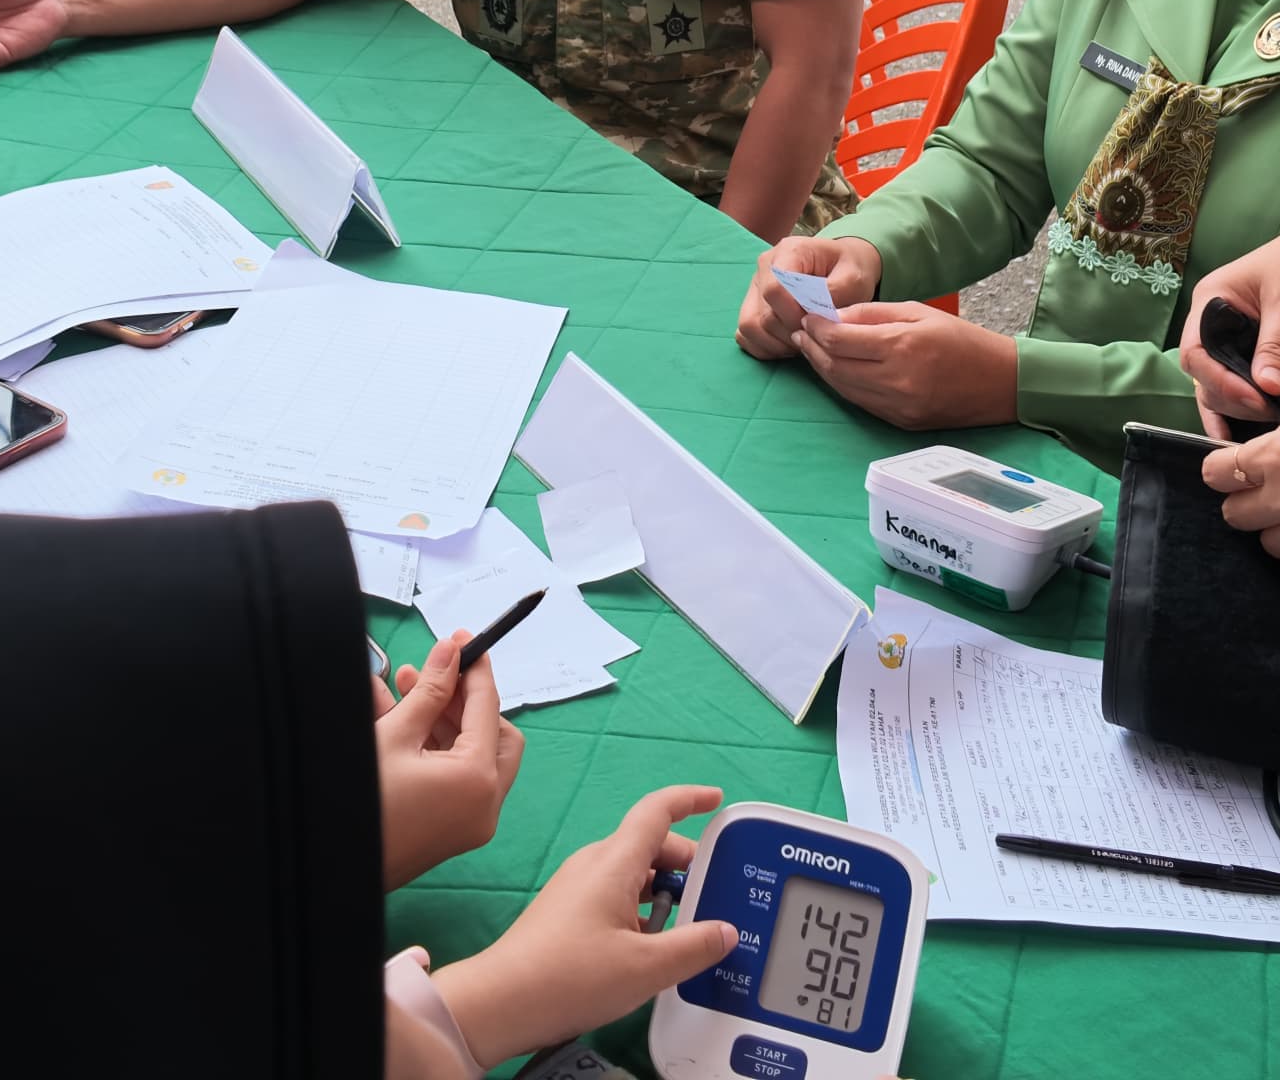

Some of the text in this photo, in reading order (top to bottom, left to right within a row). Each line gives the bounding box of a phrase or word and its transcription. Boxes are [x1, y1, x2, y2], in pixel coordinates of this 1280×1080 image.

[781, 843, 851, 875] OMRON
[748, 887, 772, 903] SYS
[739, 929, 761, 946] DIA
[800, 903, 870, 956] 142
[715, 967, 753, 987] PULSE
[803, 948, 861, 1001] 90
[816, 998, 853, 1029] 81
[755, 1045, 788, 1063] START
[753, 1062, 782, 1078] STOP
